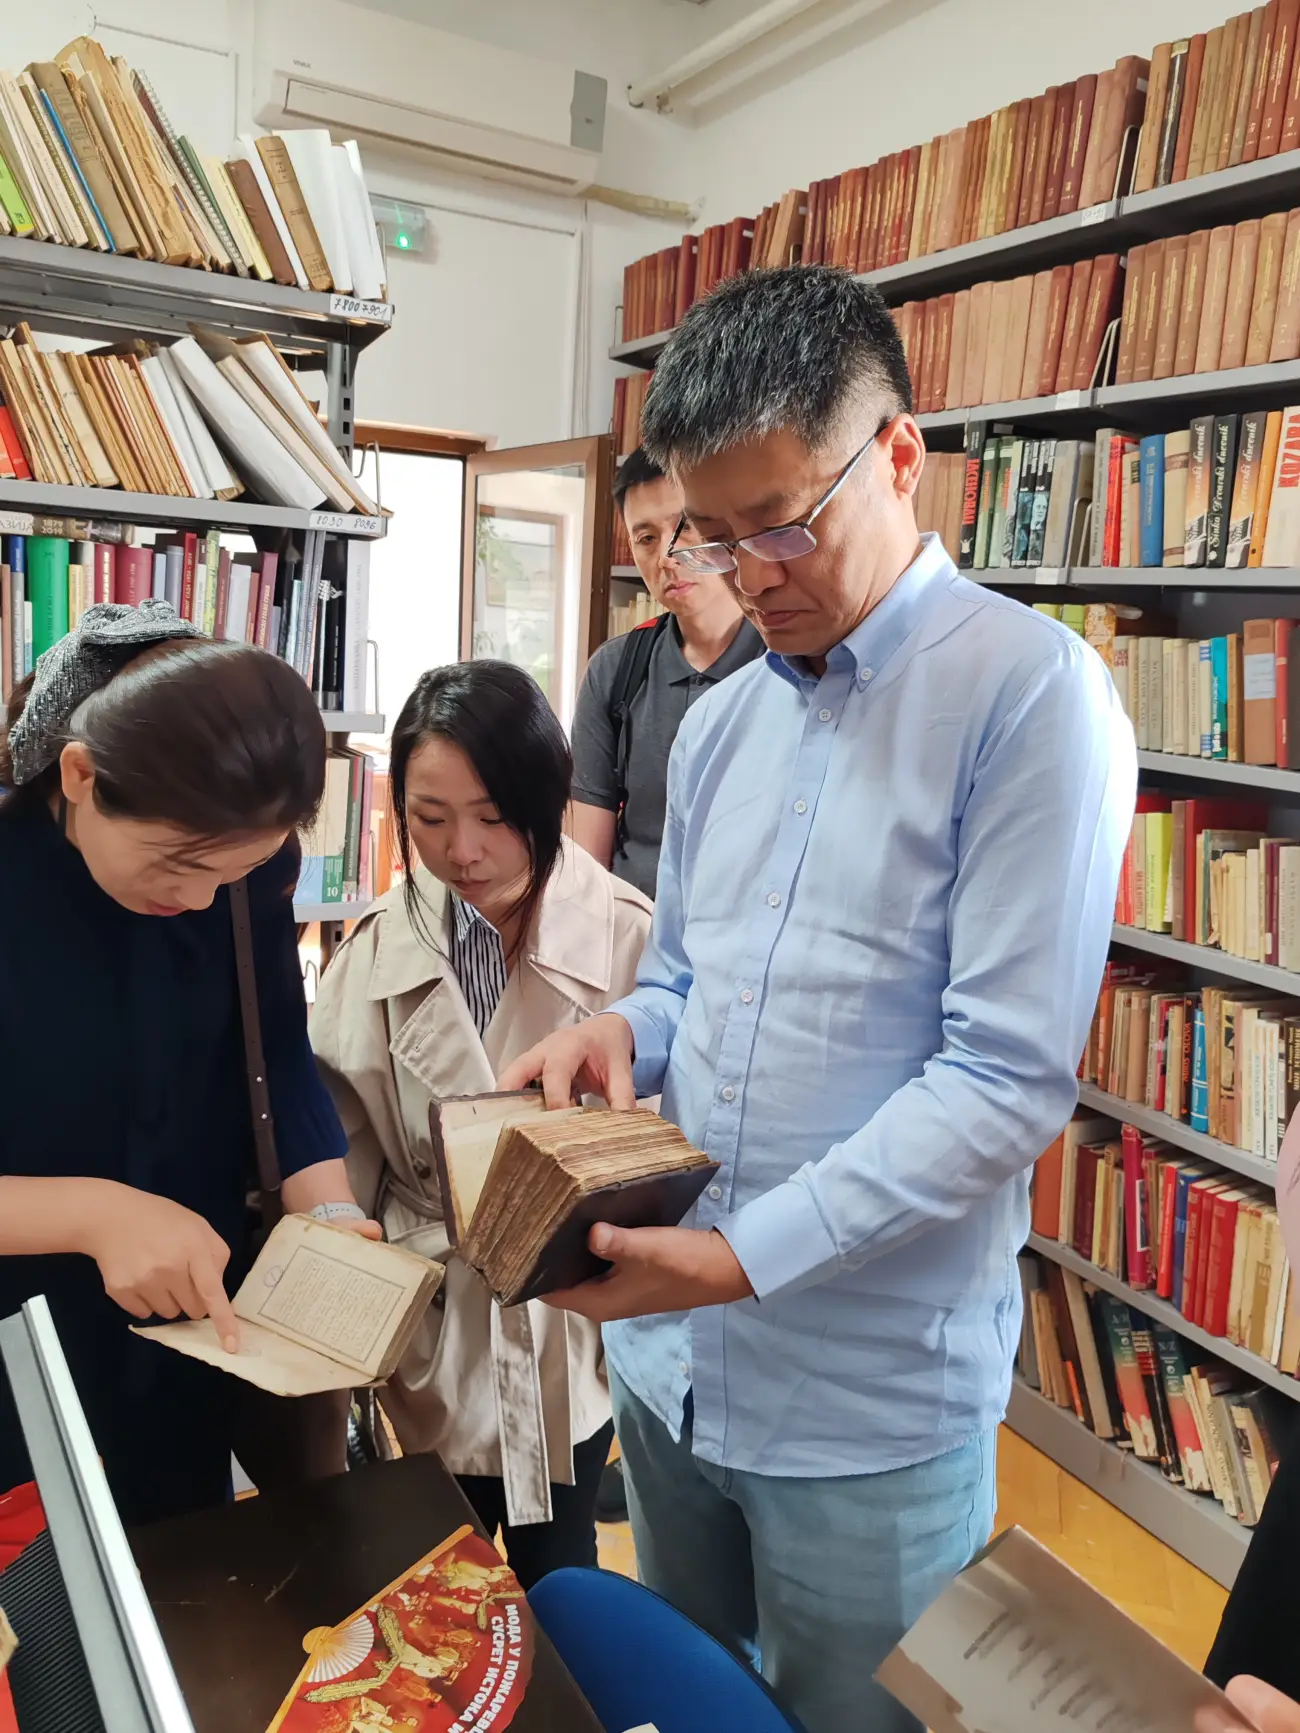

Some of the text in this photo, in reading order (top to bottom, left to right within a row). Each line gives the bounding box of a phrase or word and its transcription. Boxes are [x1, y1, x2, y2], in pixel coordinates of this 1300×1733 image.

[334, 297, 360, 312] 7800
[1194, 424, 1206, 464] dnevnik
[1242, 420, 1258, 462] dnevnik
[1209, 424, 1229, 548] Sinko Drvarski dnevnik
[42, 519, 64, 527] 1879
[327, 886, 339, 897] 10
[491, 1616, 505, 1665] СУСРЕТ
[505, 1604, 521, 1644] МОДА
[508, 1647, 522, 1657] У
[459, 1667, 500, 1722] ИСТОКА
